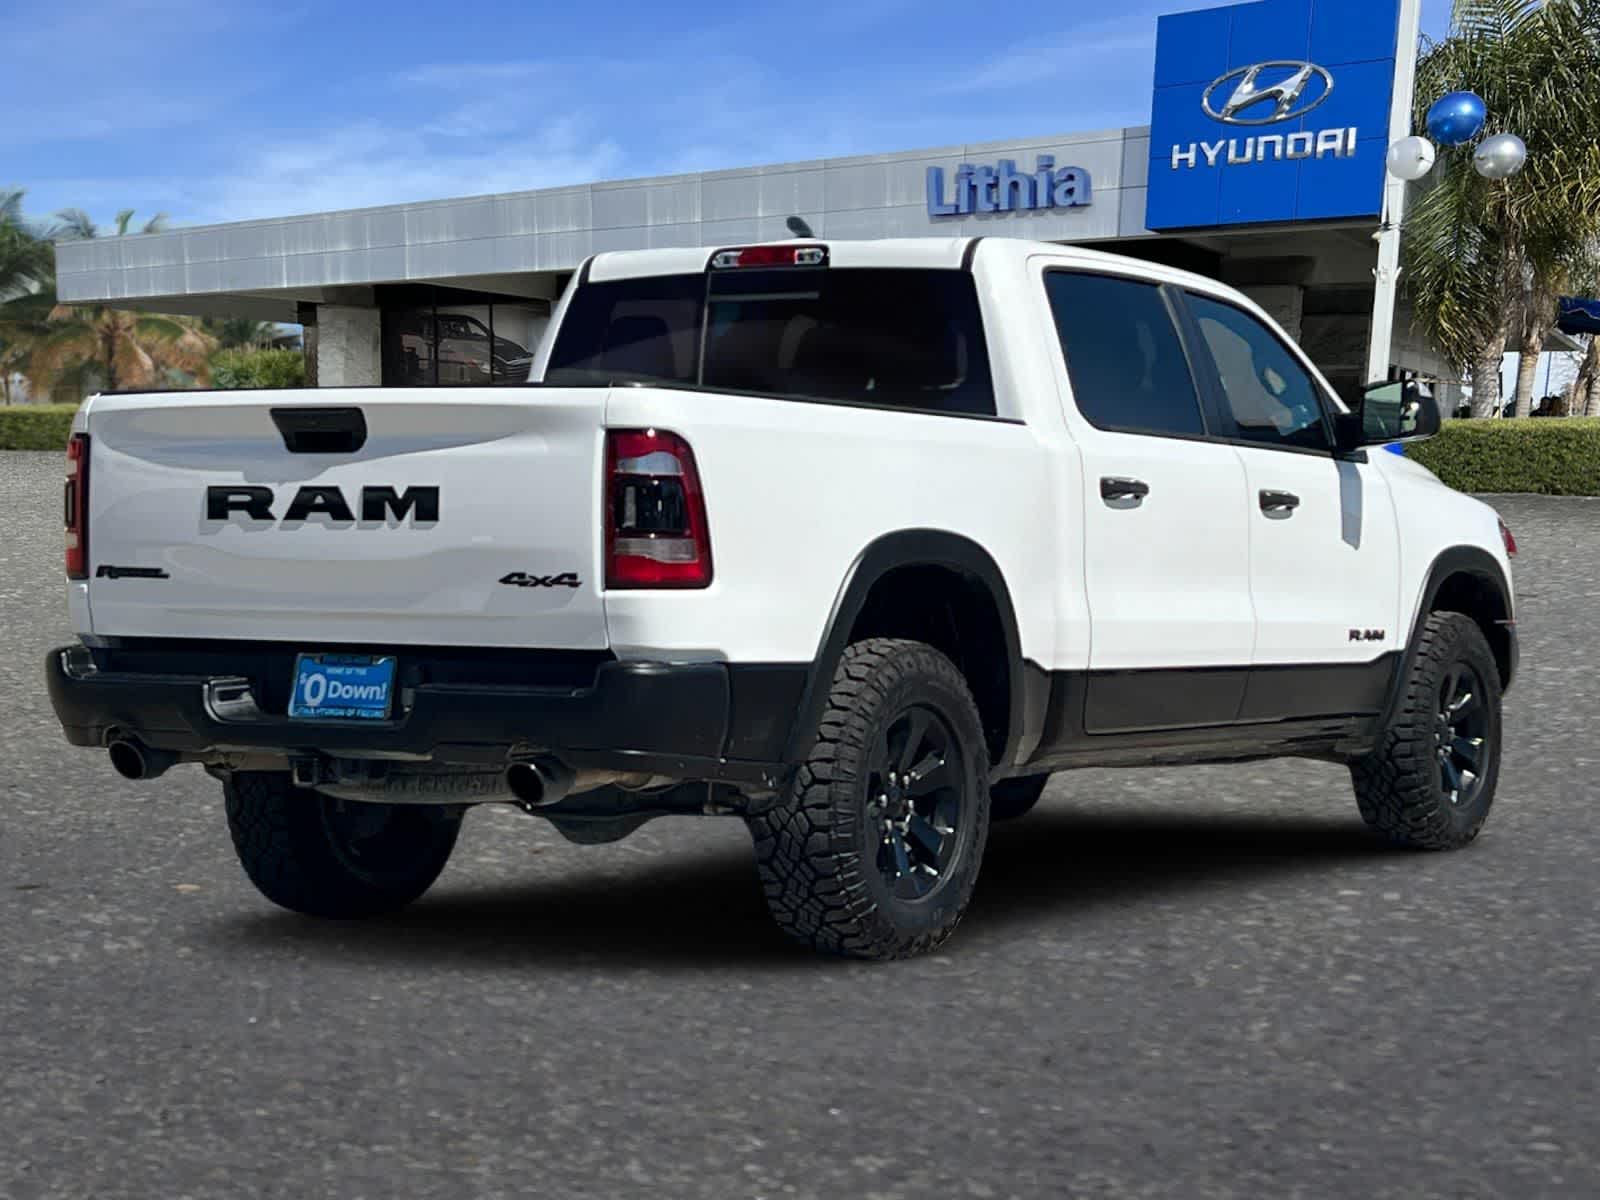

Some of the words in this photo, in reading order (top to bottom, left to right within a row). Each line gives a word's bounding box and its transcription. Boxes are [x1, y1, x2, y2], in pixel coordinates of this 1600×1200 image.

[1171, 127, 1357, 169] HYUNDAI
[926, 155, 1092, 217] Lithia
[207, 485, 440, 522] RAM
[498, 572, 582, 588] 4x4
[1348, 629, 1385, 641] RAM
[327, 681, 387, 700] Down!
